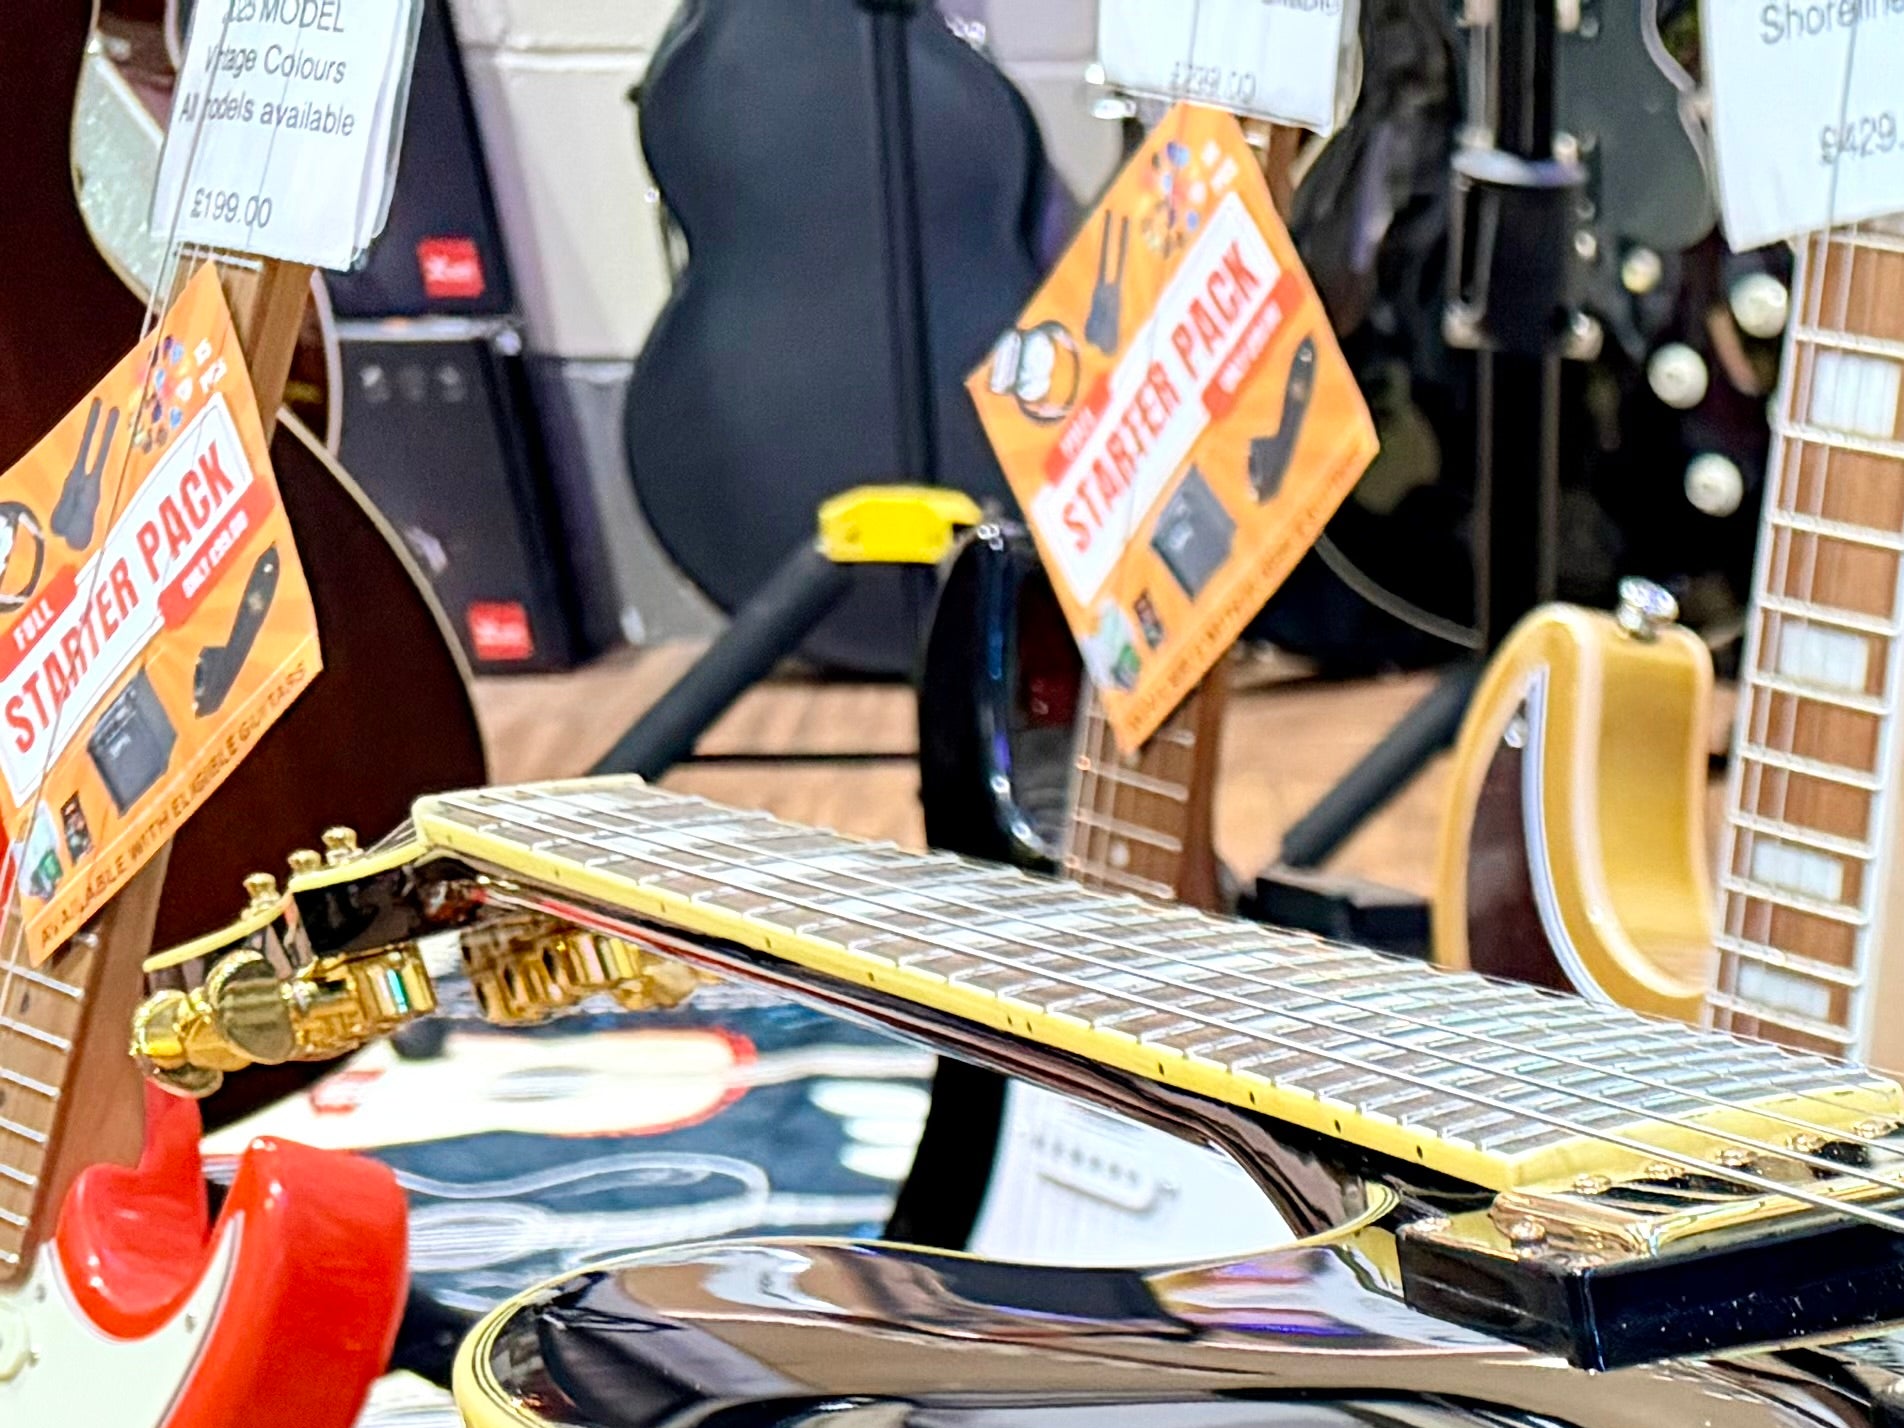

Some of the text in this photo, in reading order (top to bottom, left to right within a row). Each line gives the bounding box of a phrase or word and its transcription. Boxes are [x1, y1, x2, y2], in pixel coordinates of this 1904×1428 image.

[259, 0, 345, 33] MODEL
[205, 43, 347, 84] Vtage Colours
[179, 92, 200, 123] All
[260, 102, 355, 136] available
[190, 187, 273, 229] £199.00
[1062, 368, 1182, 555] STARTER
[1169, 241, 1263, 391] PACK
[4, 439, 235, 754] STARTER PACK
[12, 597, 55, 652] FULL
[40, 855, 128, 949] AVAABLE
